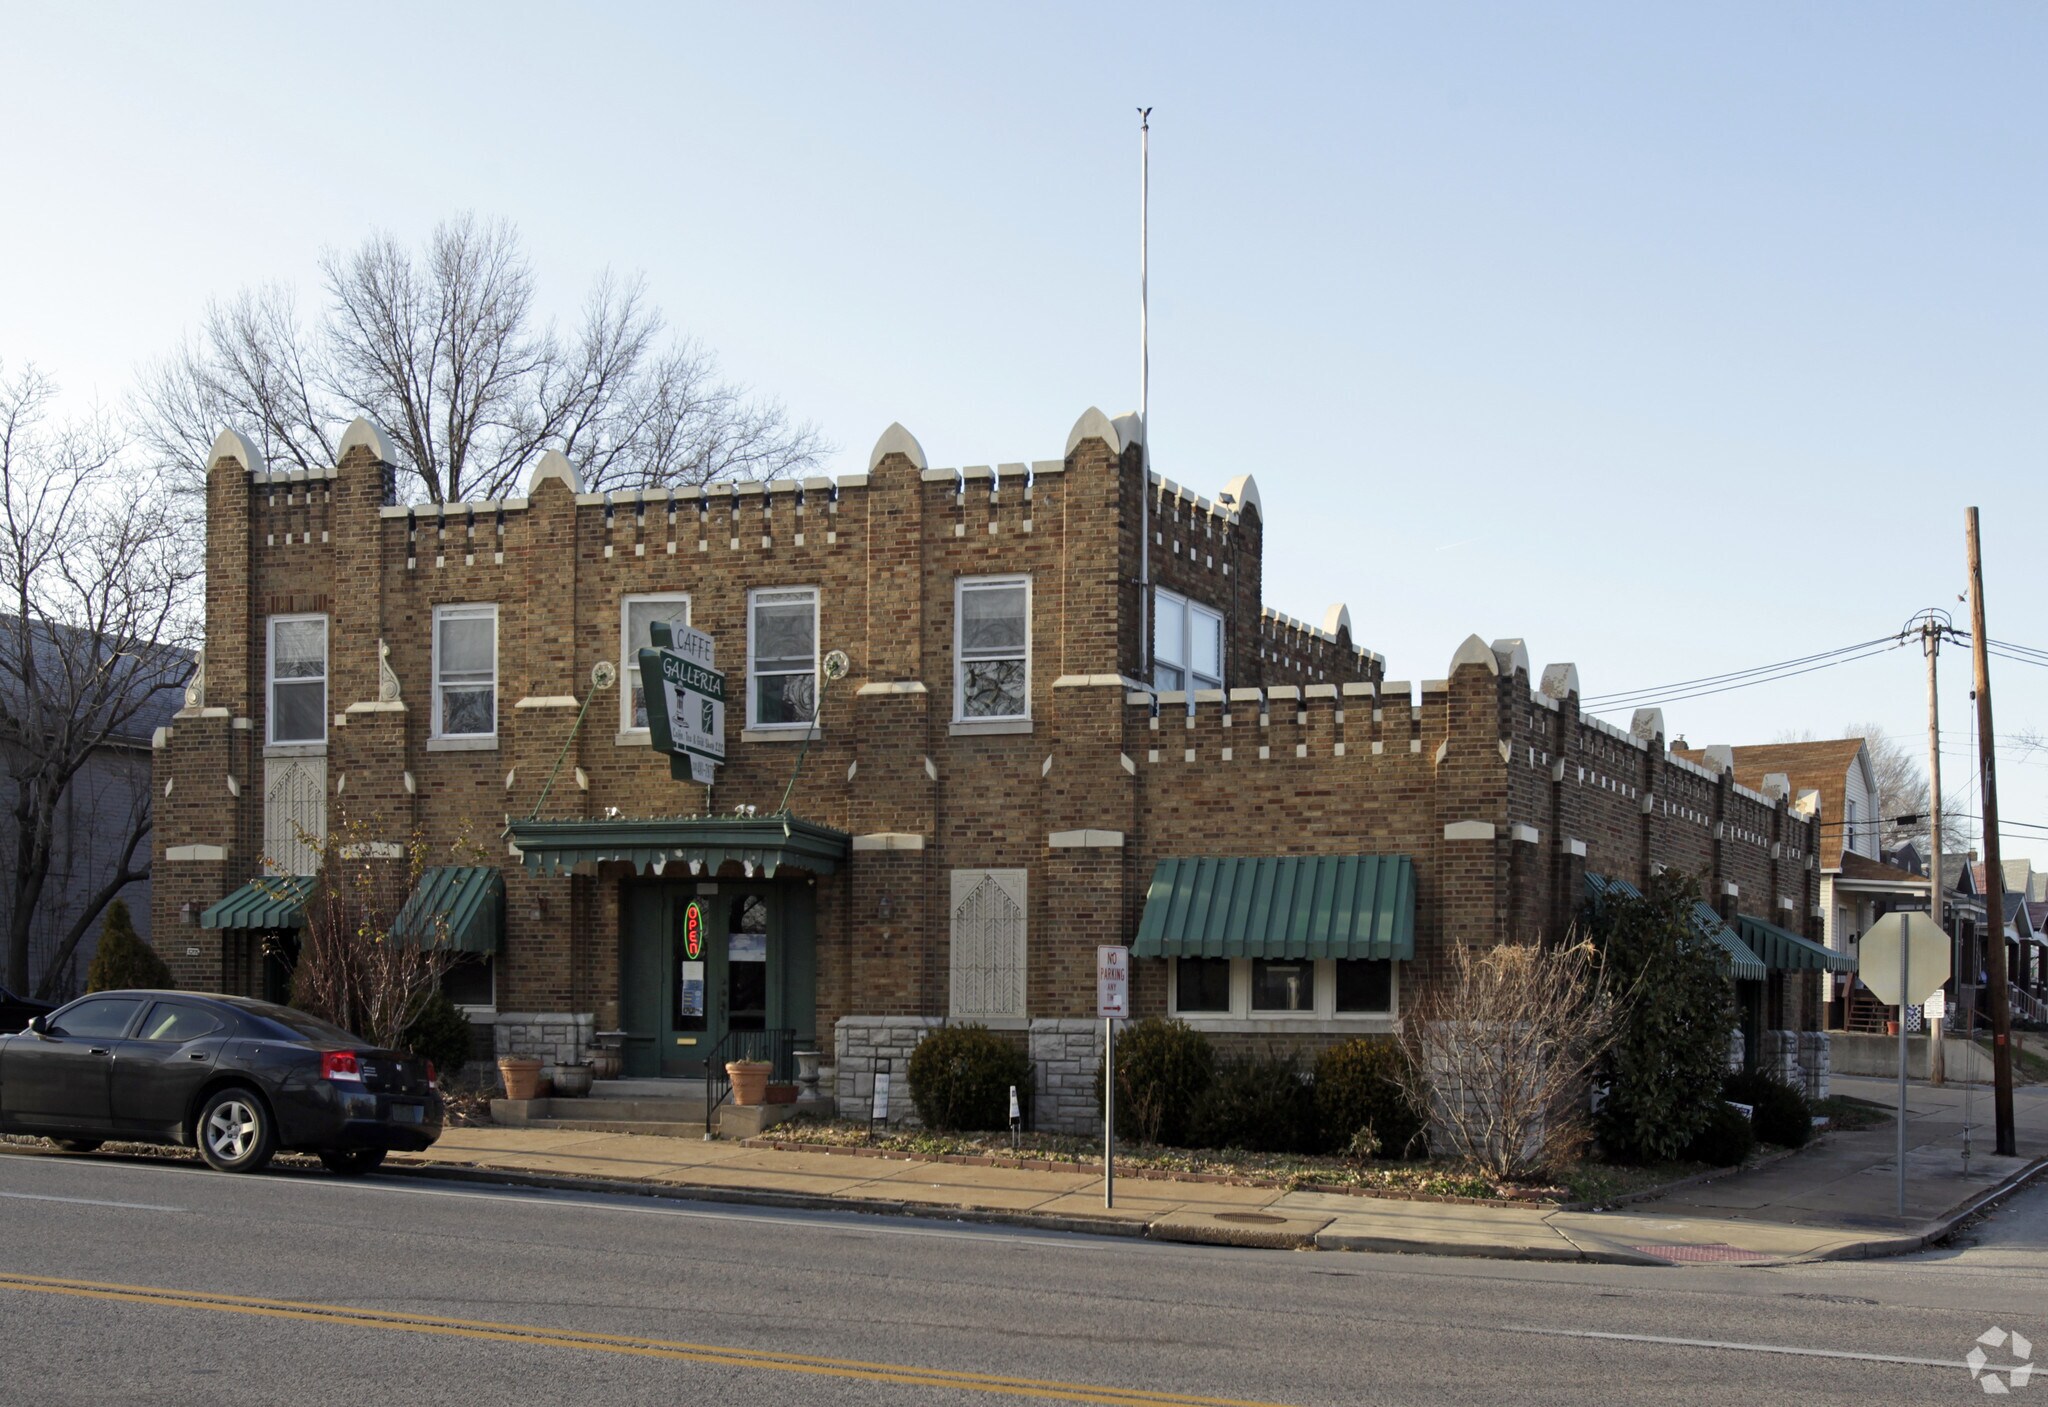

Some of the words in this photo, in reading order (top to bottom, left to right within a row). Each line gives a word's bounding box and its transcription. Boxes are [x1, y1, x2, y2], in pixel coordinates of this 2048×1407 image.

[677, 628, 711, 662] CAFFE
[663, 657, 721, 696] GALLERIA
[688, 906, 698, 954] OPEN
[1107, 952, 1117, 965] NO
[1101, 968, 1125, 982] PARKING
[1107, 983, 1117, 991] ANY
